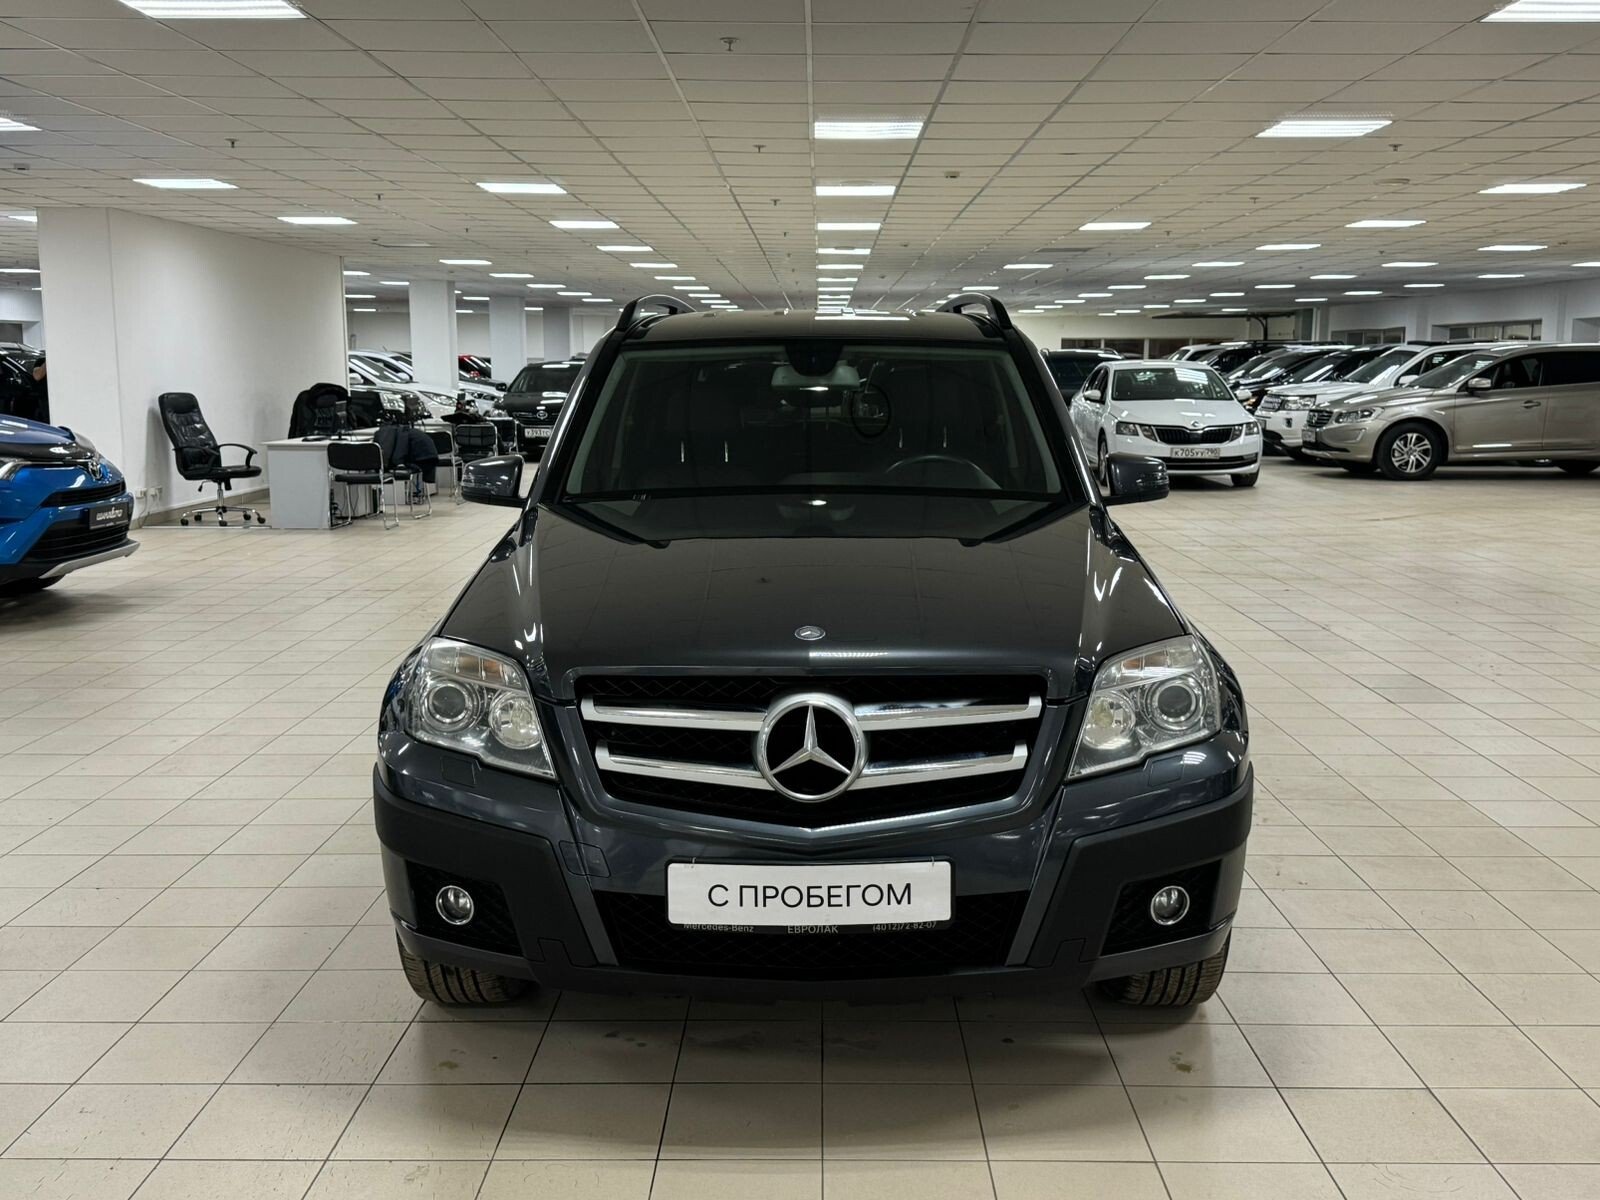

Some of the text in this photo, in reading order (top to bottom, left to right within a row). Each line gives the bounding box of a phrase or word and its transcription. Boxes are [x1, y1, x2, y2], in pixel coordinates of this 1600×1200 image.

[707, 883, 912, 908] С ПРОБЕГОМ
[683, 923, 755, 933] Mercedes-Benz
[787, 925, 839, 934] ЕВРОЛАК
